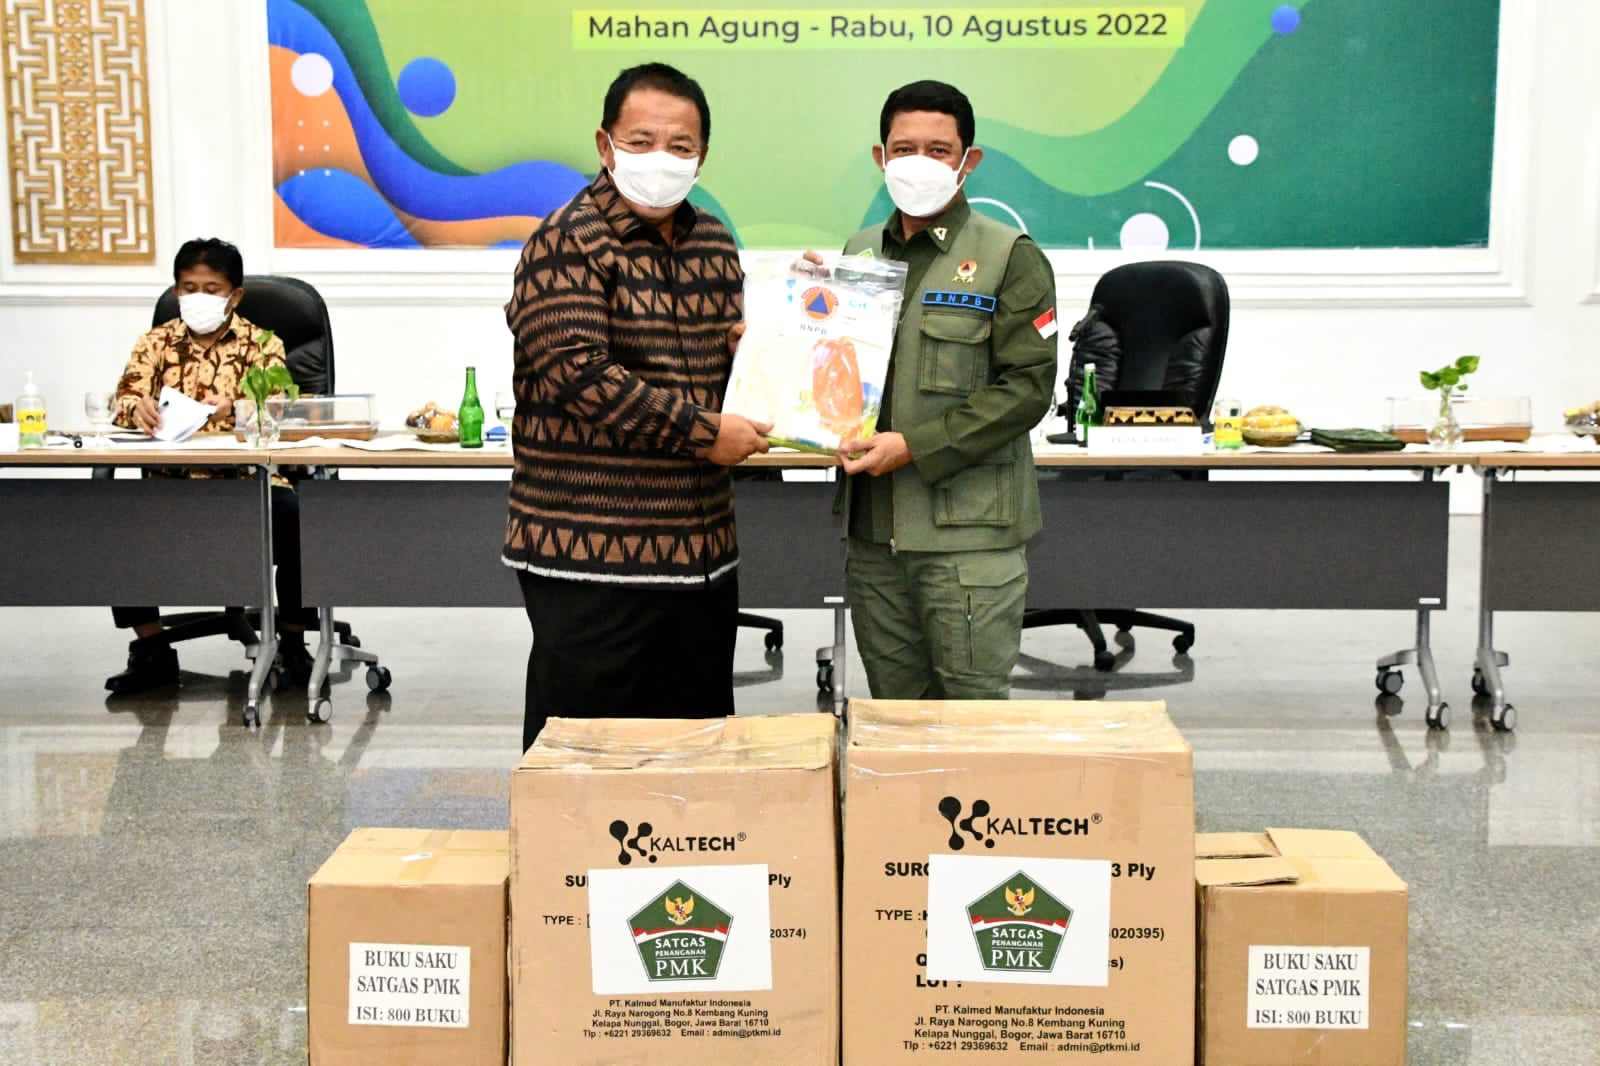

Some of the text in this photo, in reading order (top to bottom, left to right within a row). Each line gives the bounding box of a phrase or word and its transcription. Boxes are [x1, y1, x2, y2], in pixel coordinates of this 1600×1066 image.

[589, 16, 689, 38] Mahan
[699, 16, 799, 43] Agung
[830, 15, 914, 40] Rabu,
[923, 15, 953, 37] 10
[963, 15, 1087, 42] Agustus
[1096, 14, 1167, 36] 2022
[1111, 863, 1122, 877] 3
[1127, 863, 1155, 880] Ply
[565, 874, 588, 887] SU
[542, 915, 574, 926] TYPE
[875, 909, 912, 921] TYPE
[992, 928, 1044, 940] SATGAS
[1109, 928, 1164, 941] 020395)
[655, 937, 706, 948] SATGAS
[364, 950, 458, 970] BUKU SAKU
[991, 949, 1044, 967] PMK
[1263, 953, 1358, 971] BUKU SAKU
[655, 958, 708, 977] PMK
[357, 975, 461, 995] SATGAS PMK
[1255, 978, 1361, 996] SATGAS PMK
[624, 999, 657, 1007] Kalmed
[659, 999, 706, 1007] Manufaktur
[710, 999, 751, 1007] Indonesia
[356, 1006, 461, 1024] ISI: 800 BUKU
[604, 1010, 626, 1018] Raya
[629, 1010, 670, 1018] Narogong
[695, 1009, 735, 1018] Kembang
[738, 1009, 768, 1018] Kuning
[953, 1005, 991, 1014] Kalmed
[995, 1006, 1051, 1015] Manufaktur
[1055, 1006, 1104, 1015] Indonesia
[592, 1020, 621, 1028] Kelapa
[695, 1019, 717, 1027] Jawa
[719, 1019, 741, 1027] Barat
[929, 1017, 955, 1027] Raya
[958, 1018, 1008, 1028] Narogong
[1011, 1018, 1034, 1027] No.8
[1037, 1019, 1085, 1029] Kembang
[1088, 1019, 1125, 1029] Kuning
[1255, 1009, 1361, 1025] ISI: 800 BUKU
[914, 1029, 1125, 1040] Kelapa Nunggal, Bogor, Jawa Barat 16710
[928, 1042, 957, 1050] +6221
[961, 1042, 1008, 1051] 29369632
[1020, 1042, 1048, 1051] Email
[1057, 1042, 1140, 1053] admin@ptkmi.id
